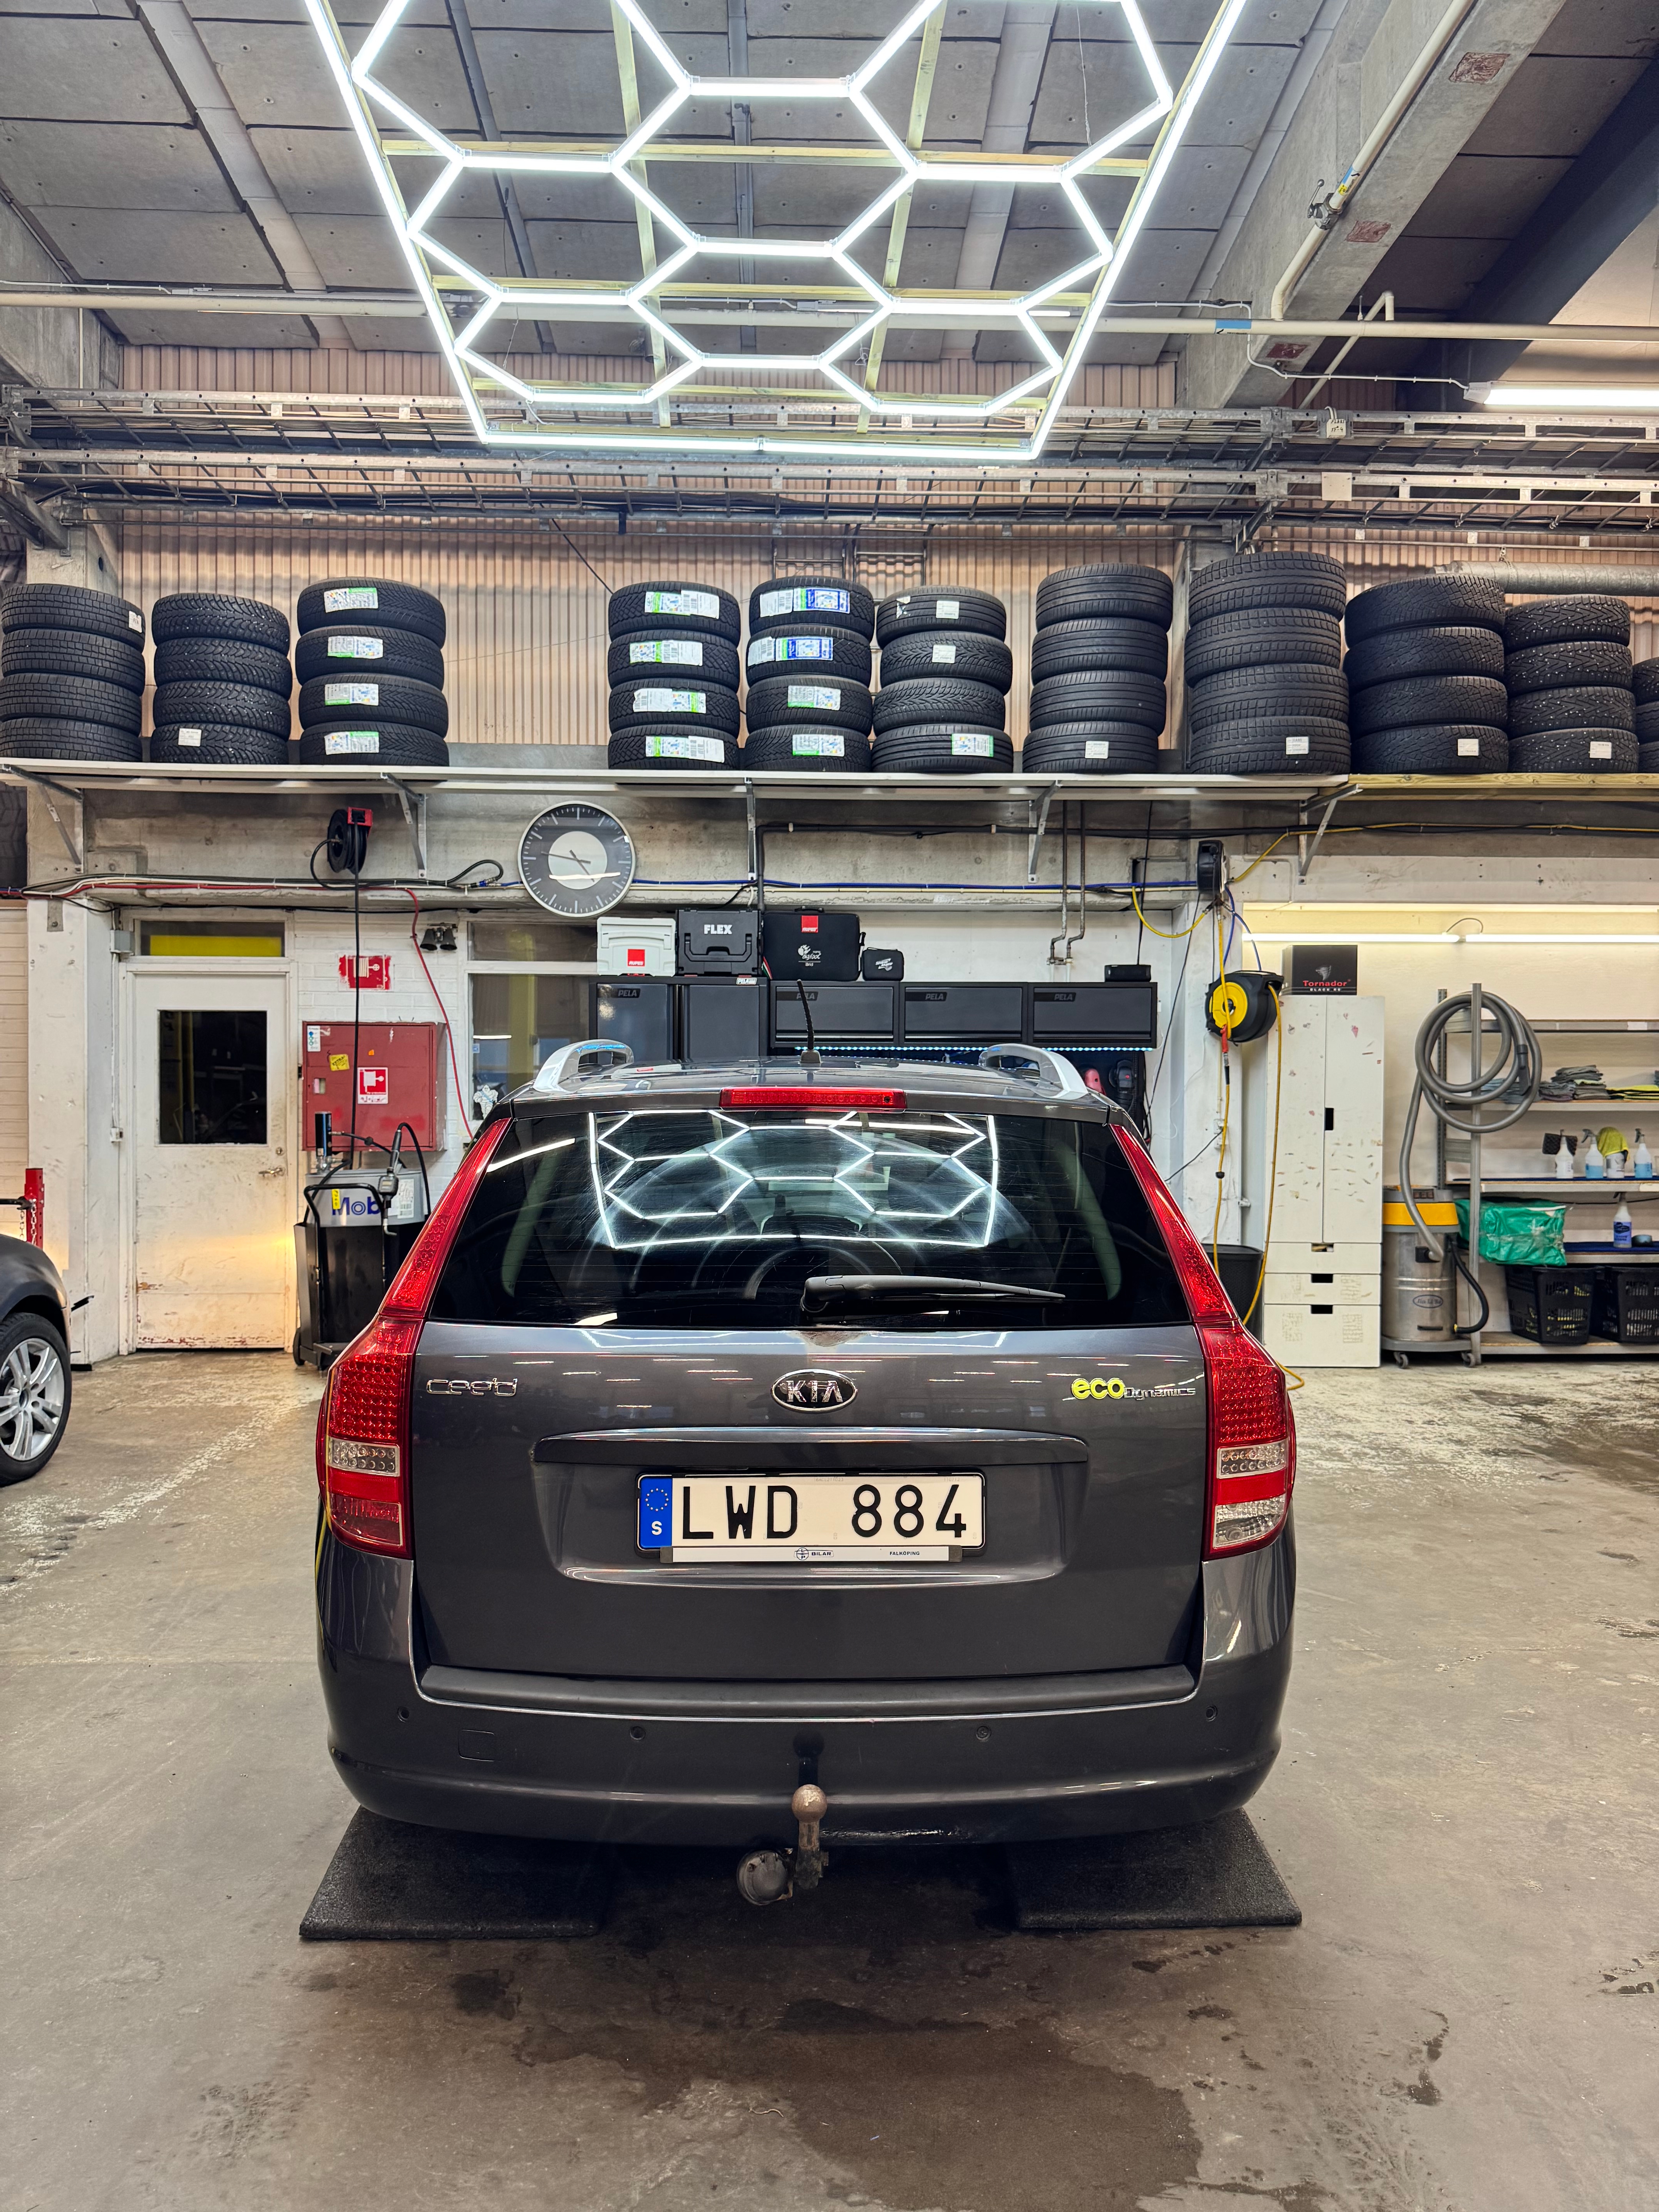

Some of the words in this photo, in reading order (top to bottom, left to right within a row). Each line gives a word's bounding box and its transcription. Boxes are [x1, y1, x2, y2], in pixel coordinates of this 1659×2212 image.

[704, 924, 732, 934] FLEX
[332, 1197, 381, 1215] Mob
[426, 1377, 518, 1396] cee'd
[786, 1380, 843, 1402] KIA
[683, 1486, 798, 1539] LWD
[852, 1484, 966, 1538] 884
[651, 1521, 662, 1535] S
